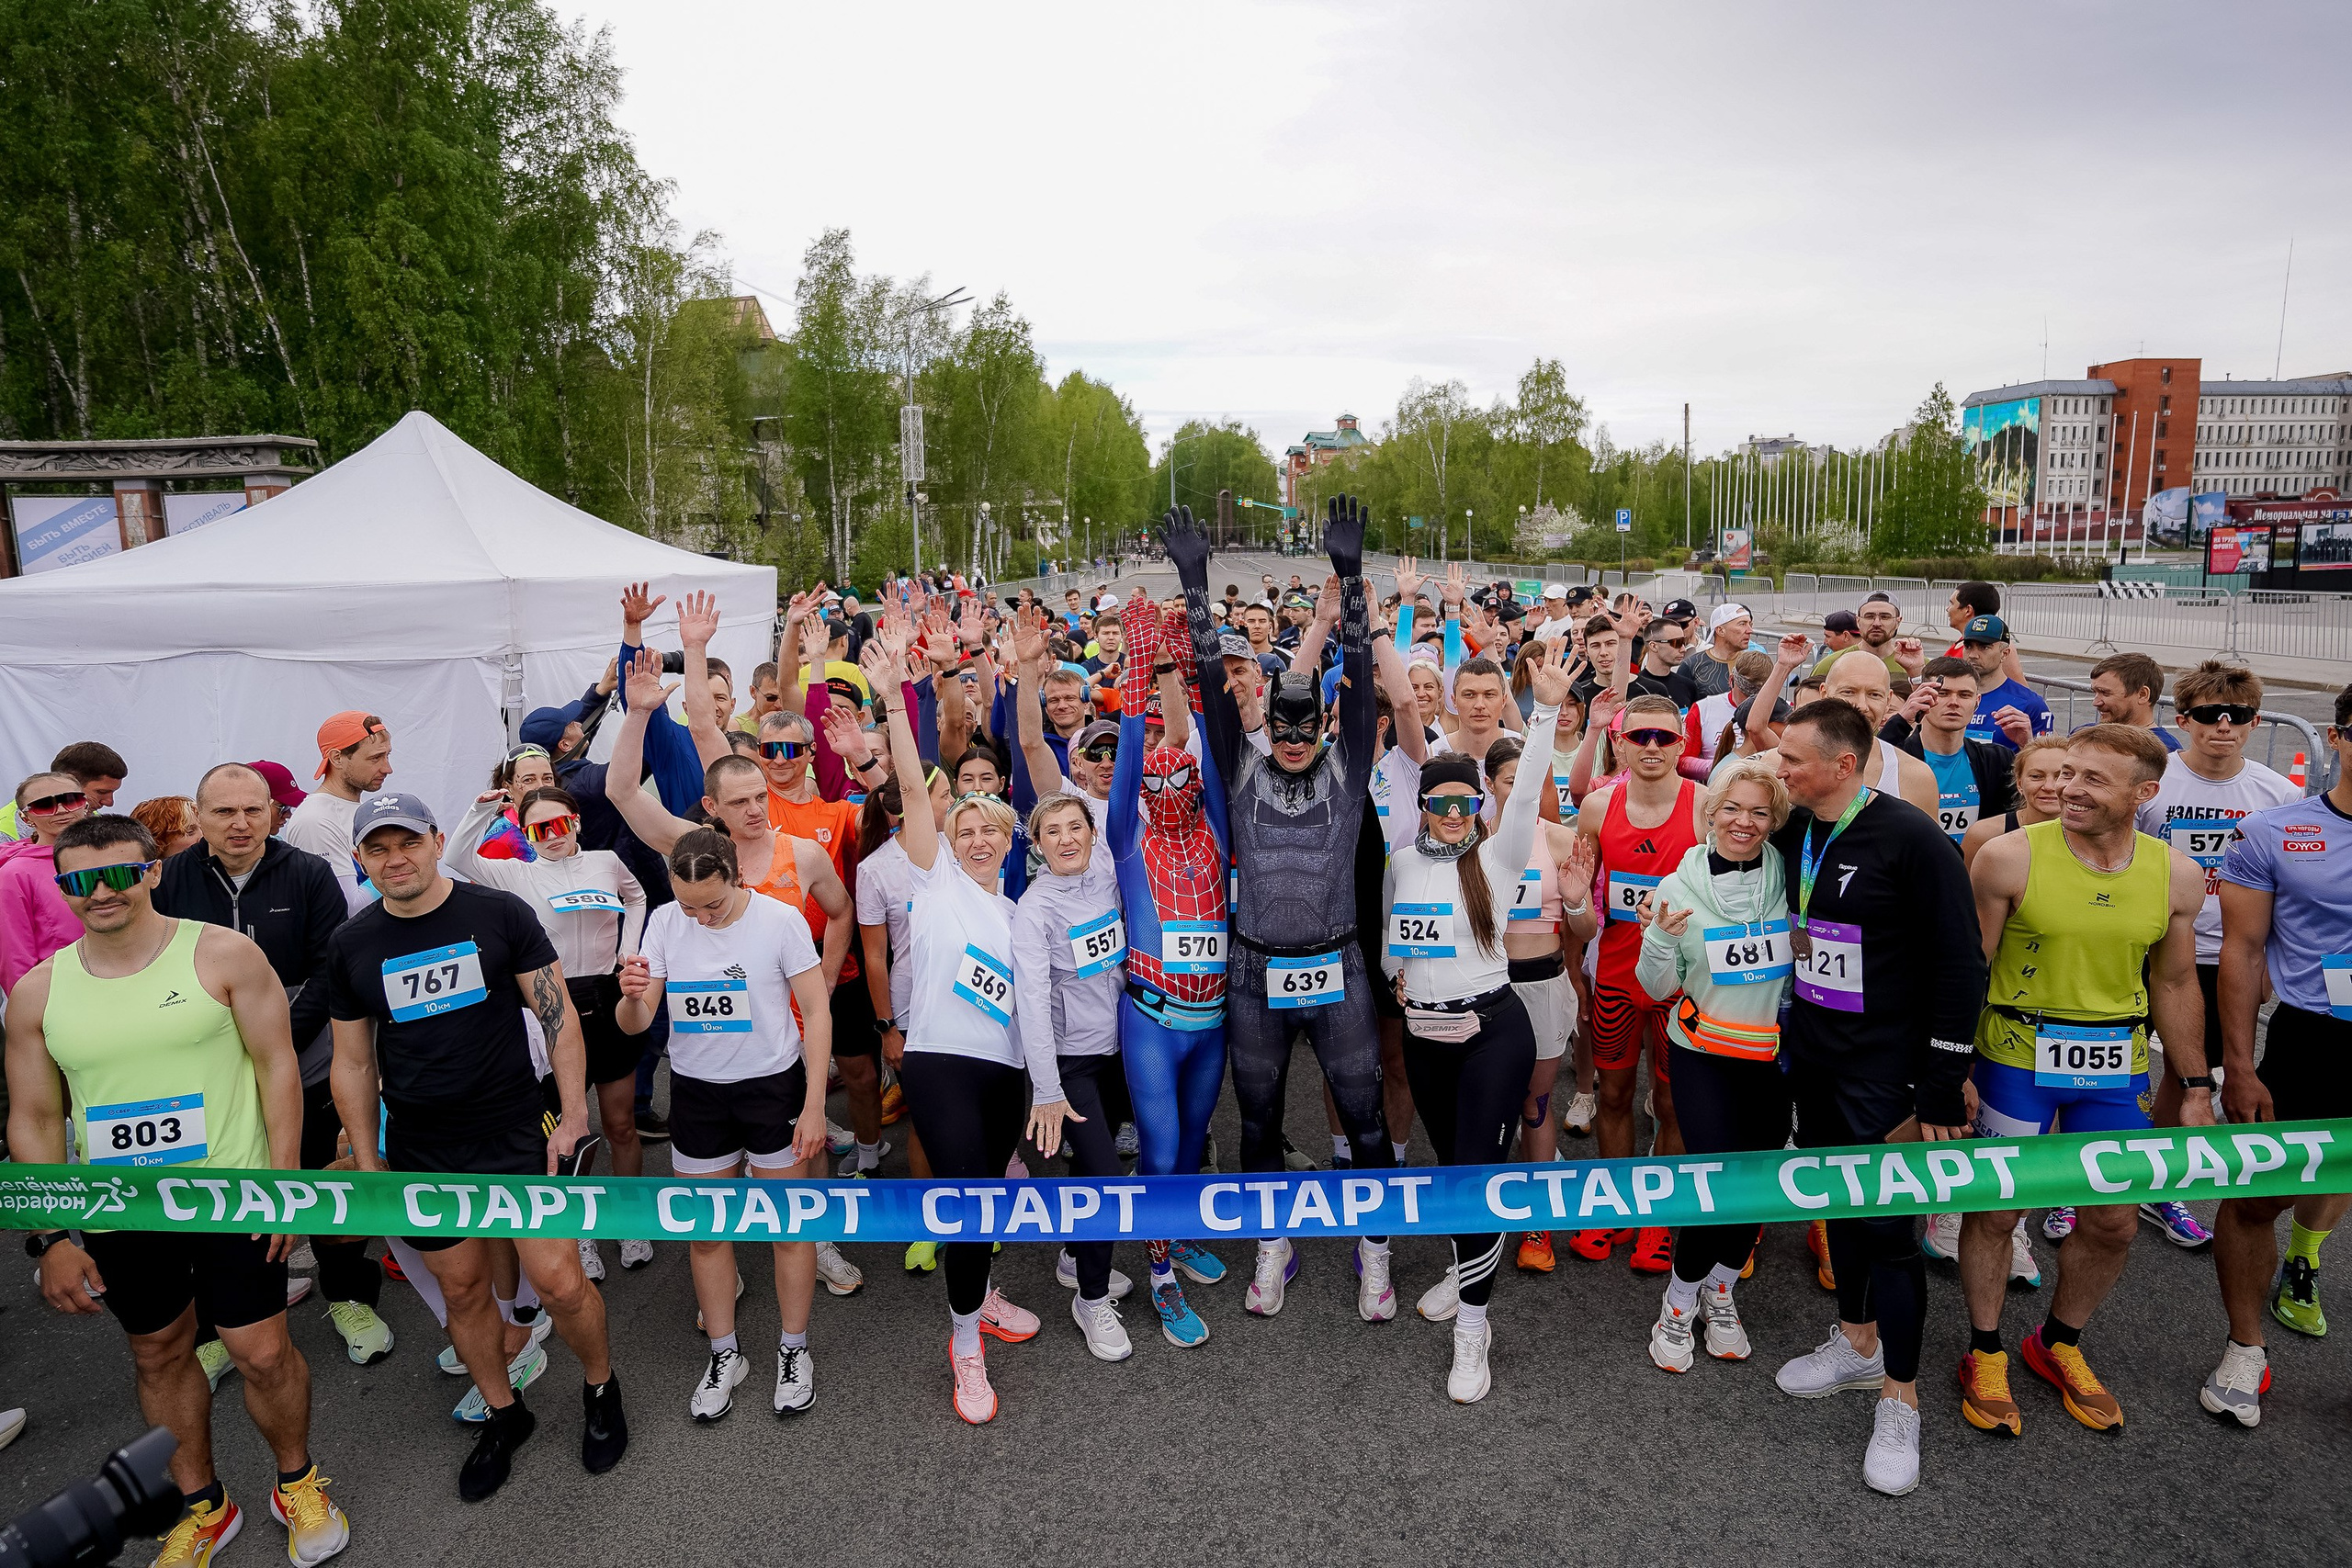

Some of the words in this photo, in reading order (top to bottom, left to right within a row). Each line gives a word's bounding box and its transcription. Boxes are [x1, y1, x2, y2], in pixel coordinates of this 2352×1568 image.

[27, 530, 61, 551] БЫТЬ
[61, 503, 108, 533] ВМЕСТЕ
[177, 501, 232, 534] ЕСТИВАЛЬ
[1620, 512, 1628, 524] P
[58, 543, 91, 564] БЫТЬ
[1970, 714, 1986, 725] БЕГ
[372, 805, 400, 815] adidas
[2190, 832, 2231, 852] 57
[565, 895, 608, 905] 580
[1399, 919, 1440, 942] 524
[1086, 927, 1117, 958] 557
[1178, 936, 1217, 957] 570
[1409, 947, 1419, 955] 10
[1725, 939, 1775, 966] 681
[1101, 959, 1109, 969] 10
[1190, 963, 1200, 972] 10
[401, 963, 460, 999] 767
[971, 964, 1007, 1002] 569
[1283, 970, 1329, 992] 639
[1742, 972, 1755, 982] 10
[159, 998, 187, 1009] DEMIX
[424, 1002, 437, 1013] 10
[684, 996, 734, 1017] 848
[975, 997, 984, 1008] 10
[1296, 998, 1306, 1006] 10
[701, 1022, 713, 1032] 10
[2048, 1043, 2123, 1070] 1055
[2072, 1077, 2085, 1087] 10
[111, 1117, 182, 1150] 803
[132, 1156, 147, 1167] 10
[2080, 1131, 2334, 1192] СТАРТ
[0, 1176, 89, 1192] елёный
[1779, 1145, 2019, 1209] СТАРТ
[1486, 1162, 1723, 1219] СТАРТ
[0, 1191, 86, 1213] арафон
[157, 1179, 354, 1224] СТАРТ
[403, 1184, 605, 1230] СТАРТ
[657, 1187, 869, 1234] СТАРТ
[922, 1186, 1146, 1234] СТАРТ
[1200, 1177, 1432, 1231] СТАРТ
